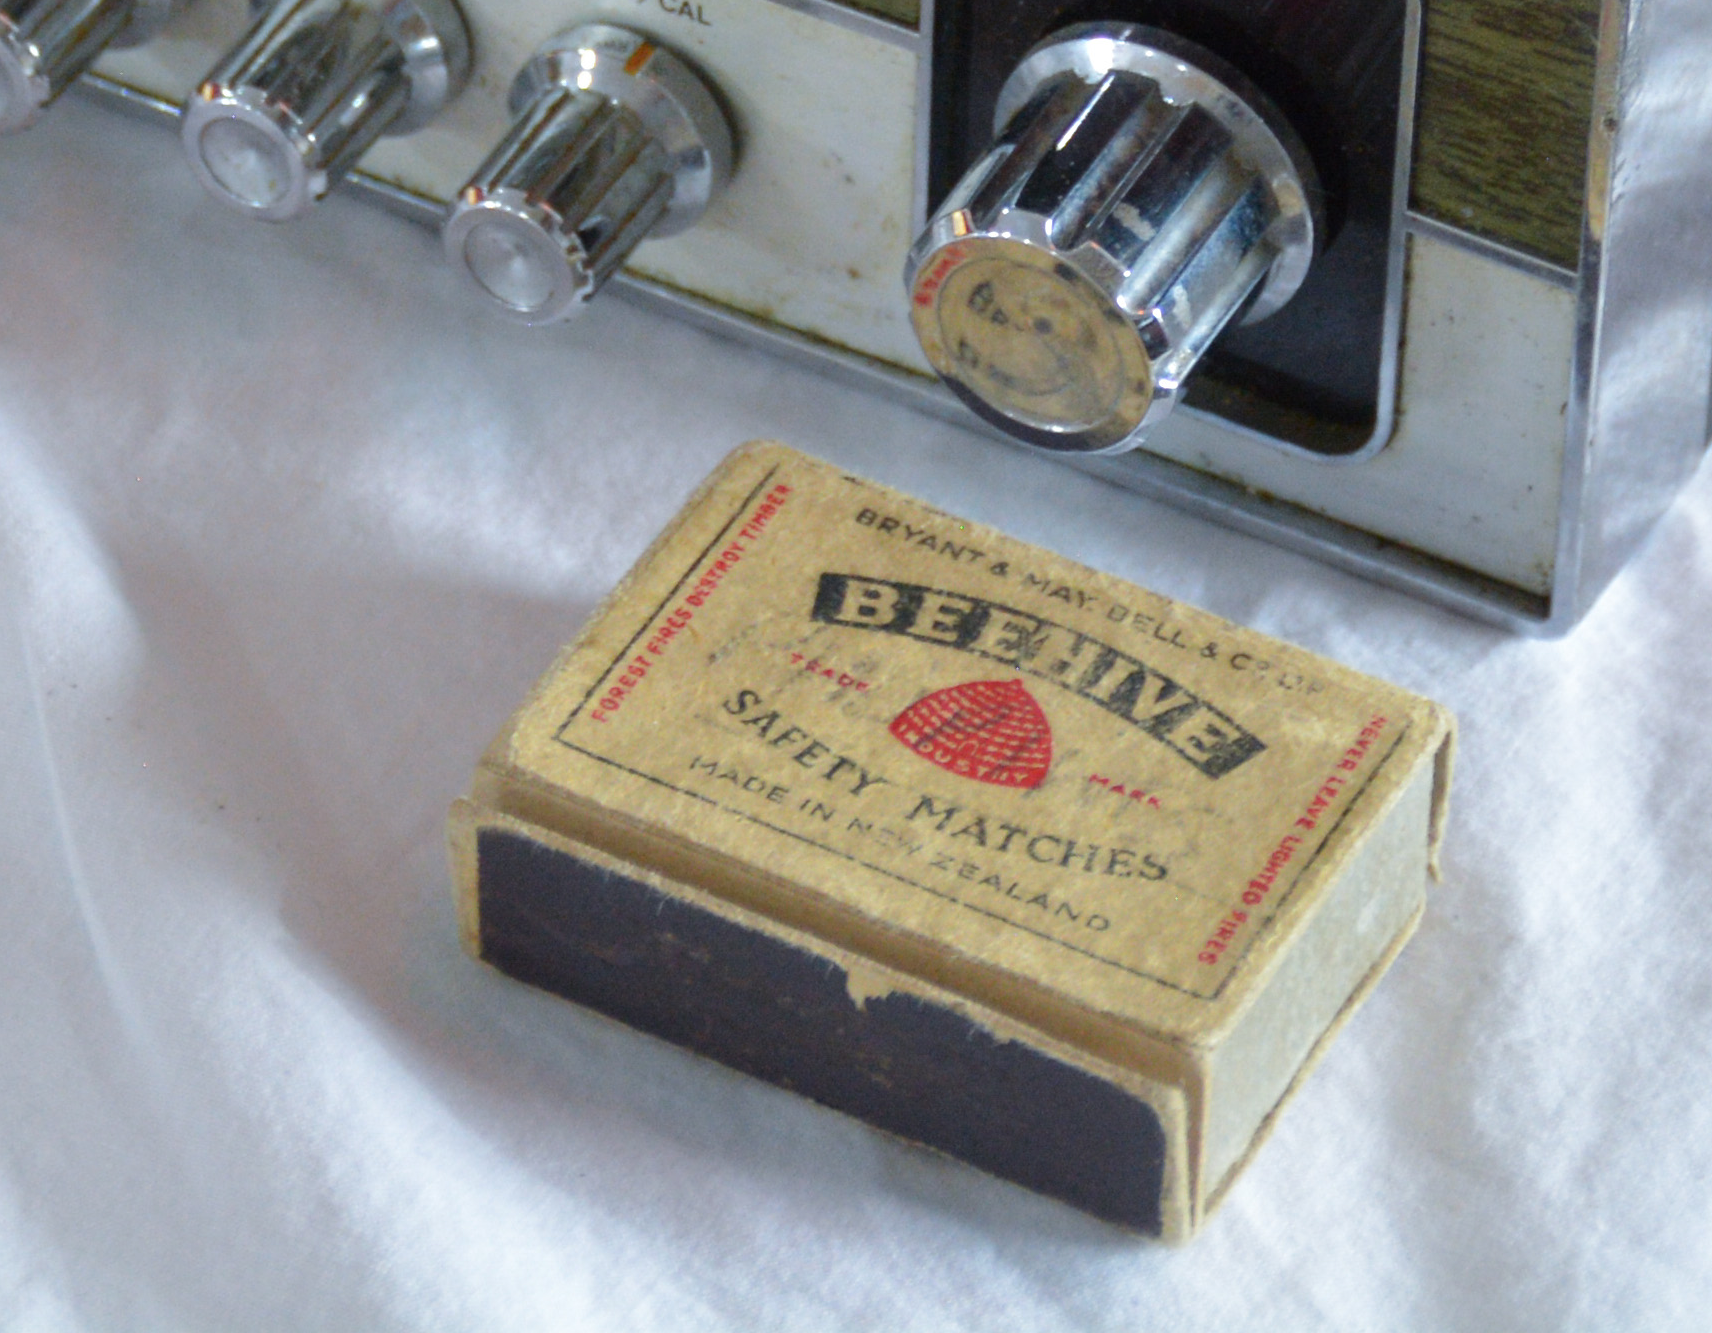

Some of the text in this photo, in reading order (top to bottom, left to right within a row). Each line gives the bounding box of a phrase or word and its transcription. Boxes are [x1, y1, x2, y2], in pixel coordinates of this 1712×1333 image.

[591, 482, 793, 724] FOREST FIRES DESTROY TIMBER
[790, 650, 870, 693] TRADE
[827, 574, 1257, 771] BEEHIVE
[855, 507, 986, 563] BRYANT
[990, 560, 1010, 578] &
[1200, 641, 1219, 661] &
[688, 755, 789, 803] MADE
[799, 797, 836, 823] IN
[928, 851, 1112, 933] ZEALAND
[721, 687, 1169, 882] SAFETY MATCHES
[1088, 773, 1161, 810] MARK
[1195, 709, 1390, 969] NEVER LEAVE LIGHTED FIRES
